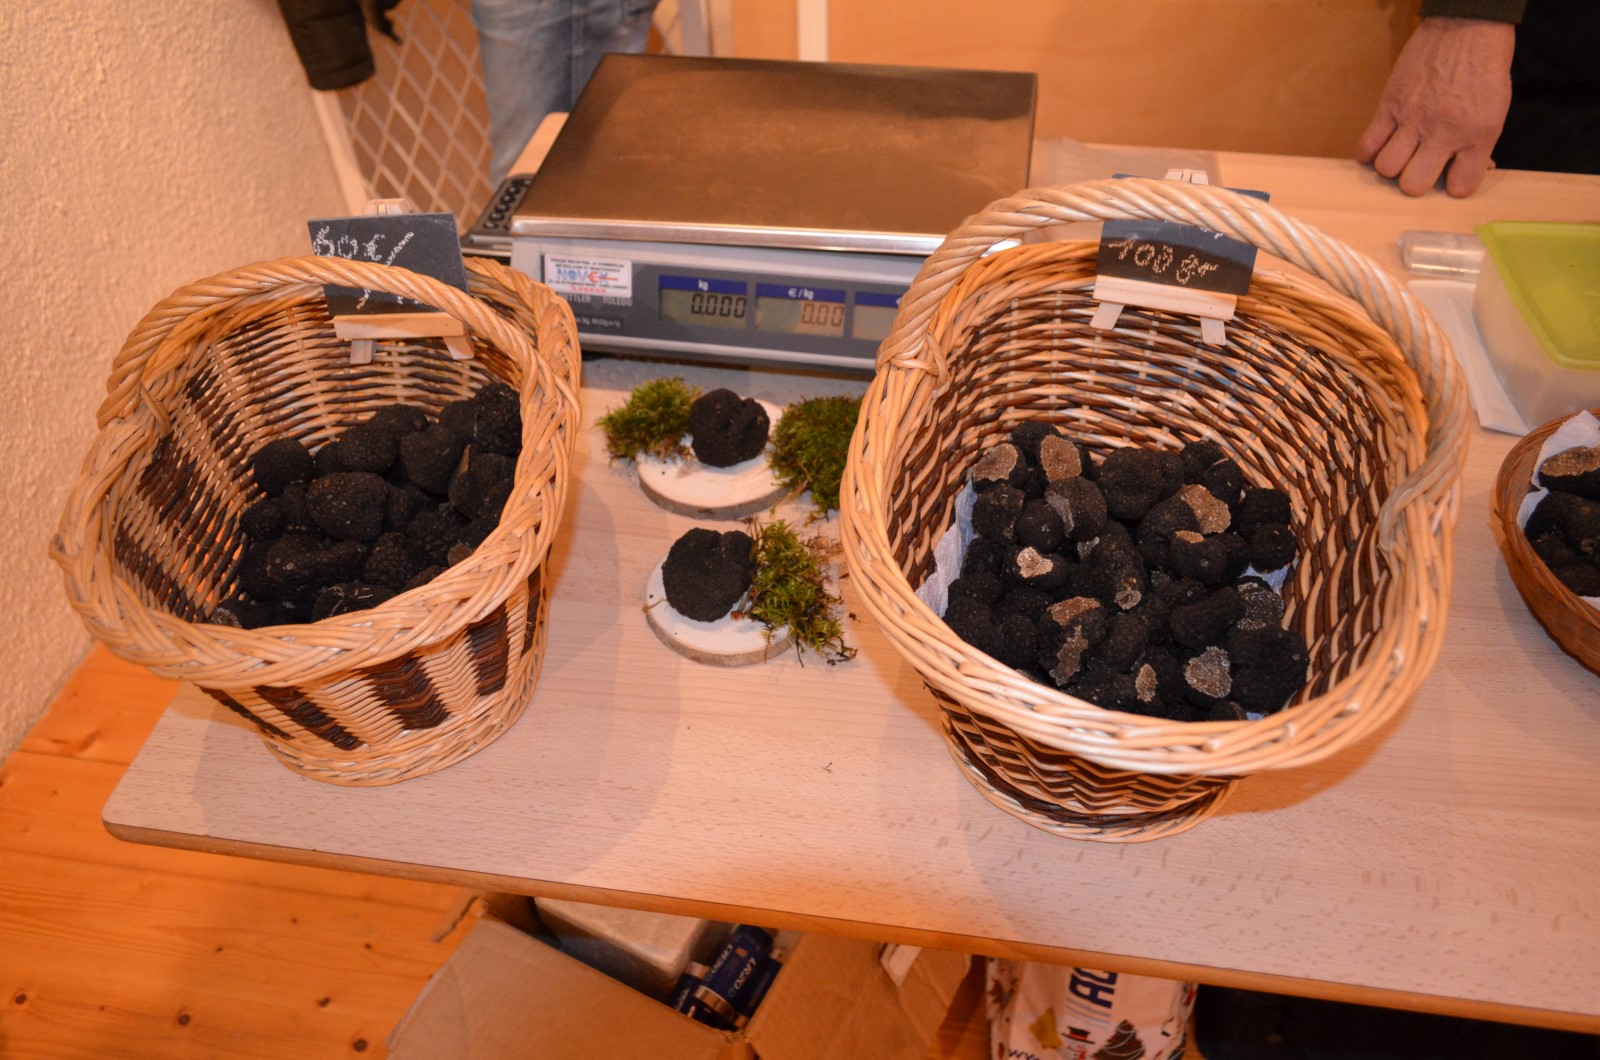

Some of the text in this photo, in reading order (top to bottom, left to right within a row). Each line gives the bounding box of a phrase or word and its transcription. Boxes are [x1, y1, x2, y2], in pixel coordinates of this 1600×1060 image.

[698, 279, 709, 291] kg
[691, 293, 747, 318] 0.000
[801, 303, 844, 327] 0.00
